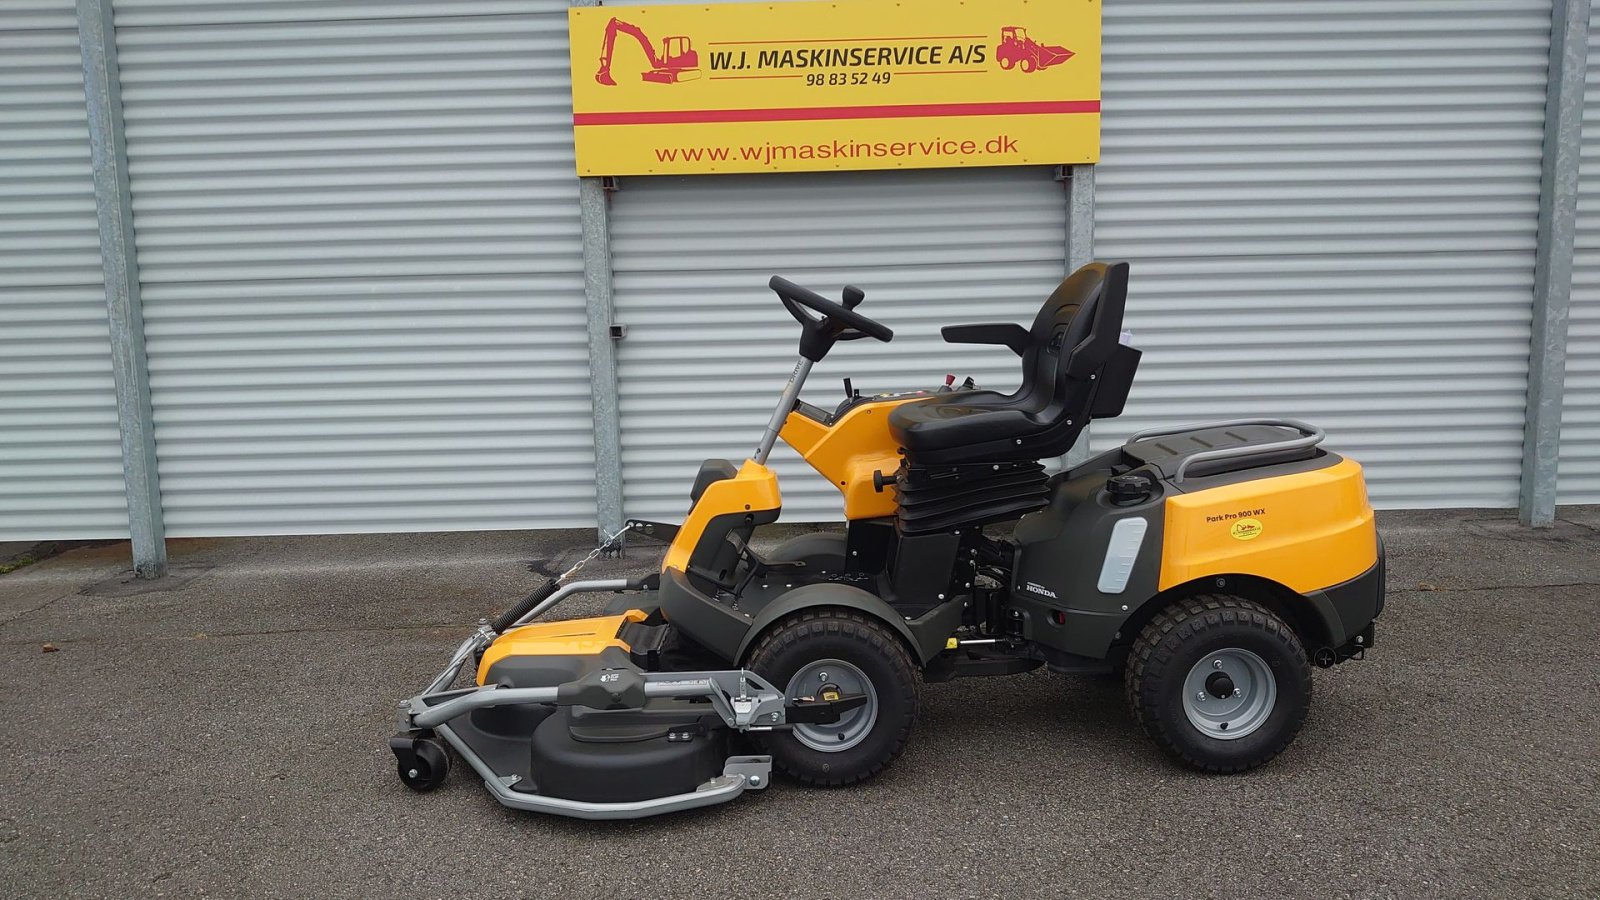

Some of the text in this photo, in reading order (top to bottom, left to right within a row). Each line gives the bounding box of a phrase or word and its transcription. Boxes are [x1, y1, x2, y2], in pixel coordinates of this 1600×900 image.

[709, 44, 987, 70] W.J. MASKINSERVICE A/S
[806, 71, 891, 86] 98 83 52 49
[655, 135, 1019, 165] www.wjmaskinservice.dk
[1206, 515, 1224, 523] Park
[1238, 510, 1252, 518] 900
[1253, 508, 1266, 516] WX
[1026, 585, 1058, 599] HONDA
